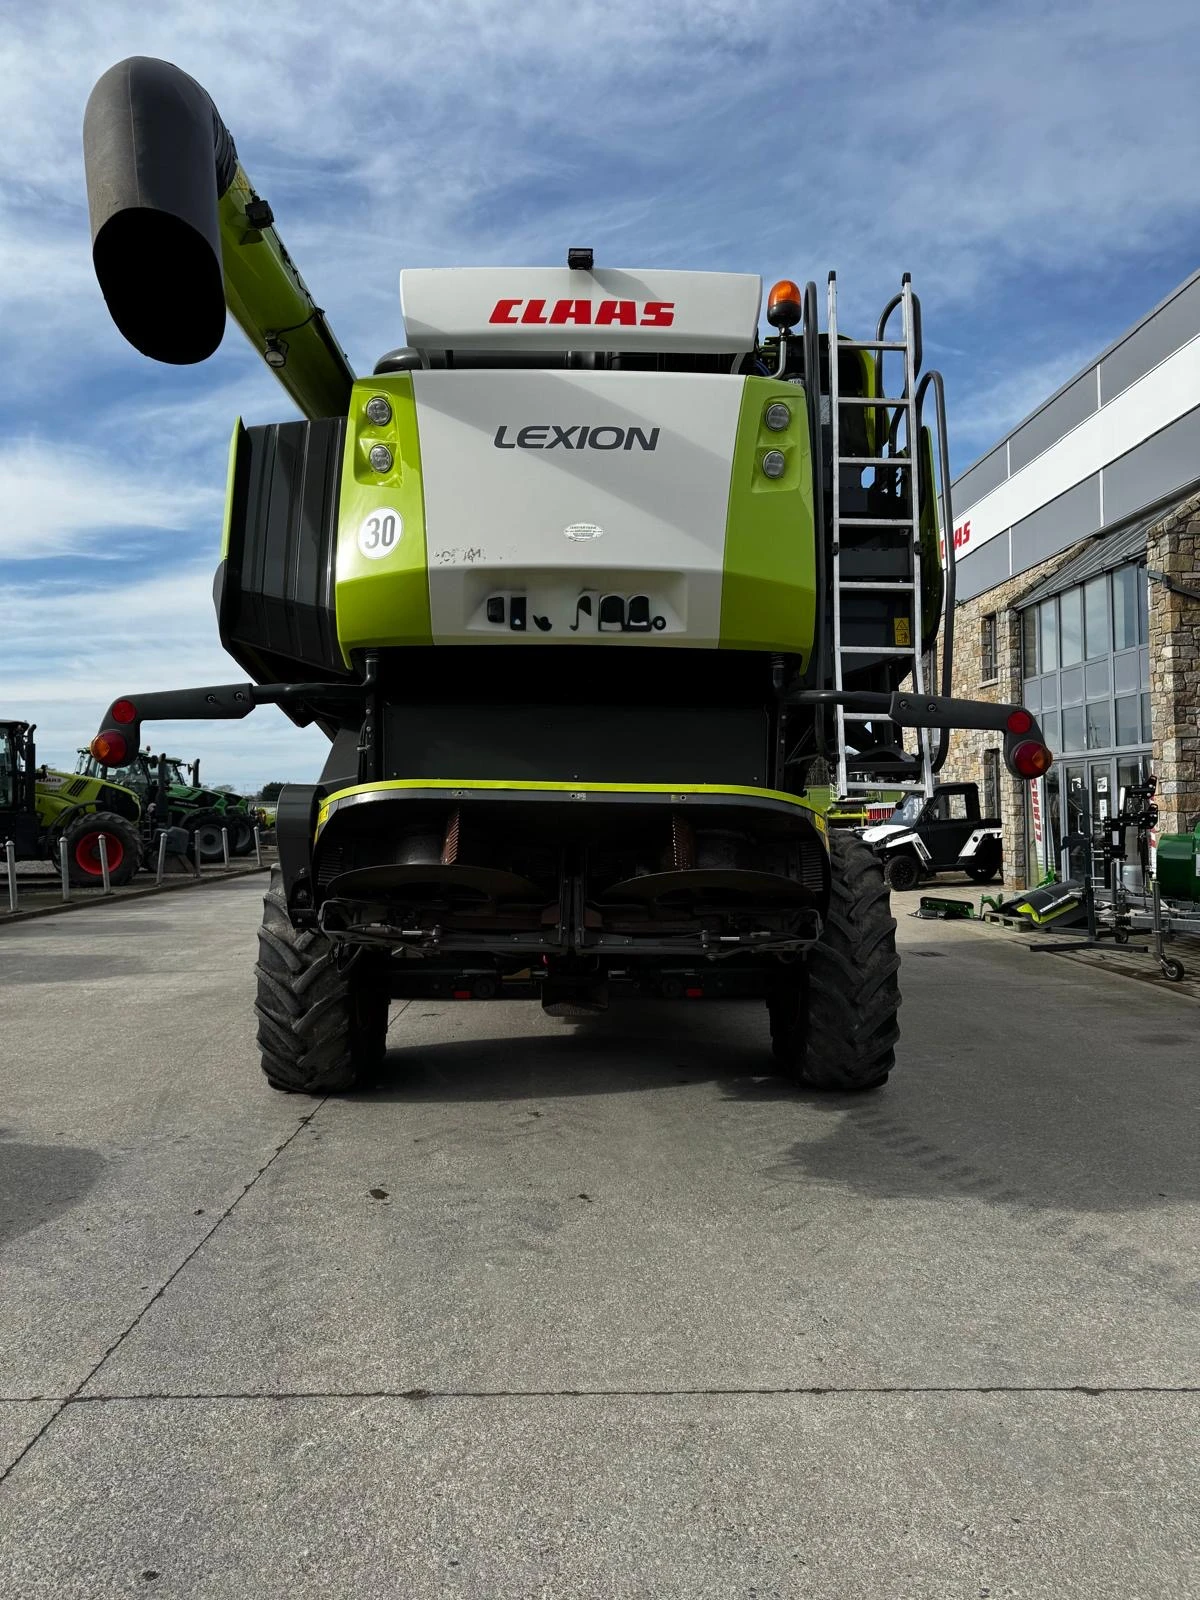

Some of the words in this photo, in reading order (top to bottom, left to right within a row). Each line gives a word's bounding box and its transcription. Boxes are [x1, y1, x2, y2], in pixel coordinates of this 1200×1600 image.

[489, 299, 675, 326] CLAAS
[494, 426, 660, 451] LEXION
[365, 515, 396, 549] 30
